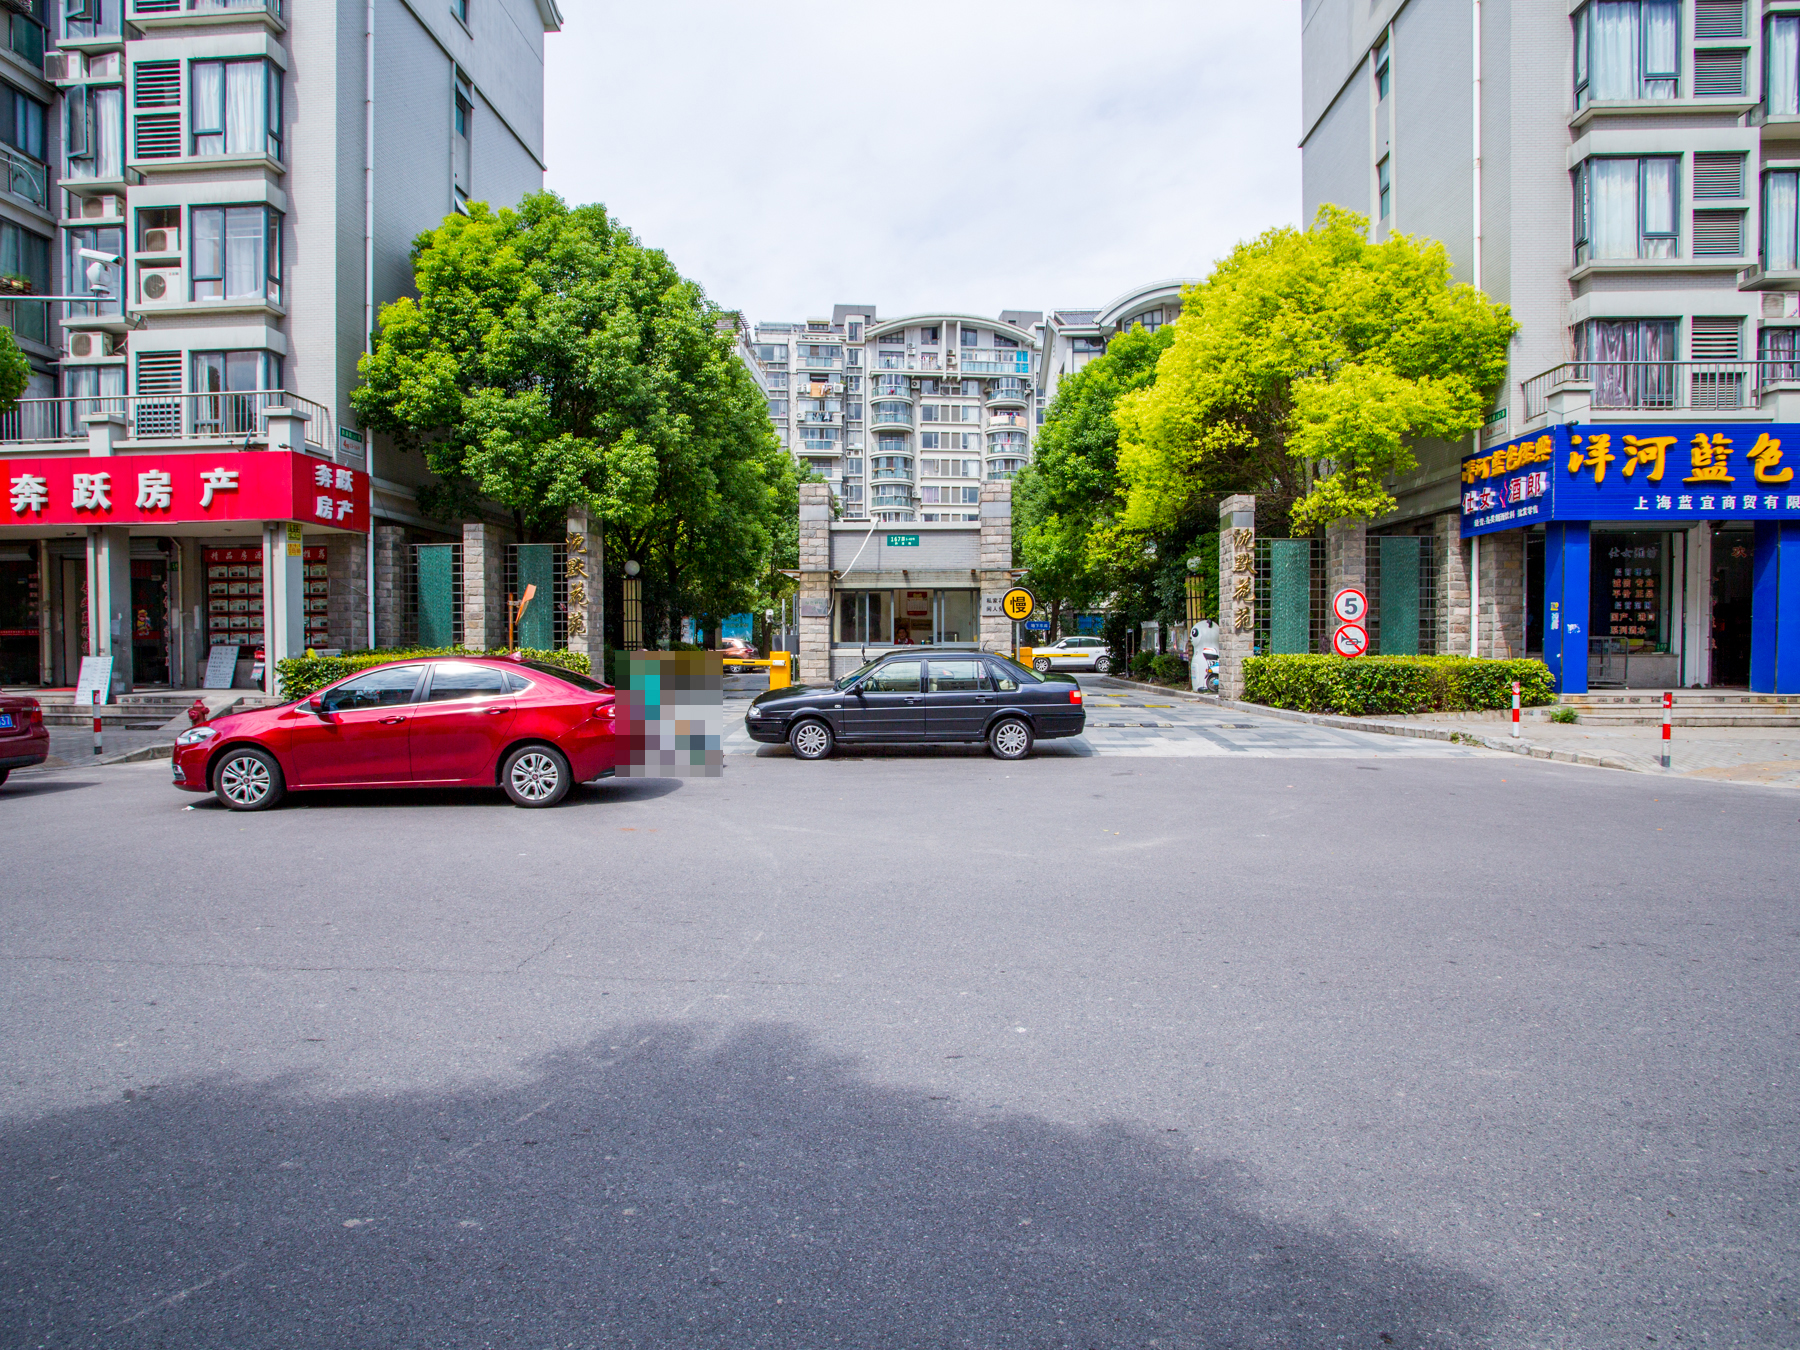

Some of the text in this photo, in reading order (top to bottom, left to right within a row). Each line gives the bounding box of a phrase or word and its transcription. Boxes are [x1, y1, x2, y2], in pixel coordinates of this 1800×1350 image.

[315, 464, 353, 493] 奔跃
[9, 467, 240, 513] 奔跃房产
[1462, 487, 1496, 515] 仕女
[315, 495, 353, 521] 房产
[1634, 494, 1800, 510] 上海蓝宜商贸有限
[1010, 596, 1027, 613] 慢
[1344, 597, 1358, 615] 5
[1610, 625, 1647, 635] 系列酒水
